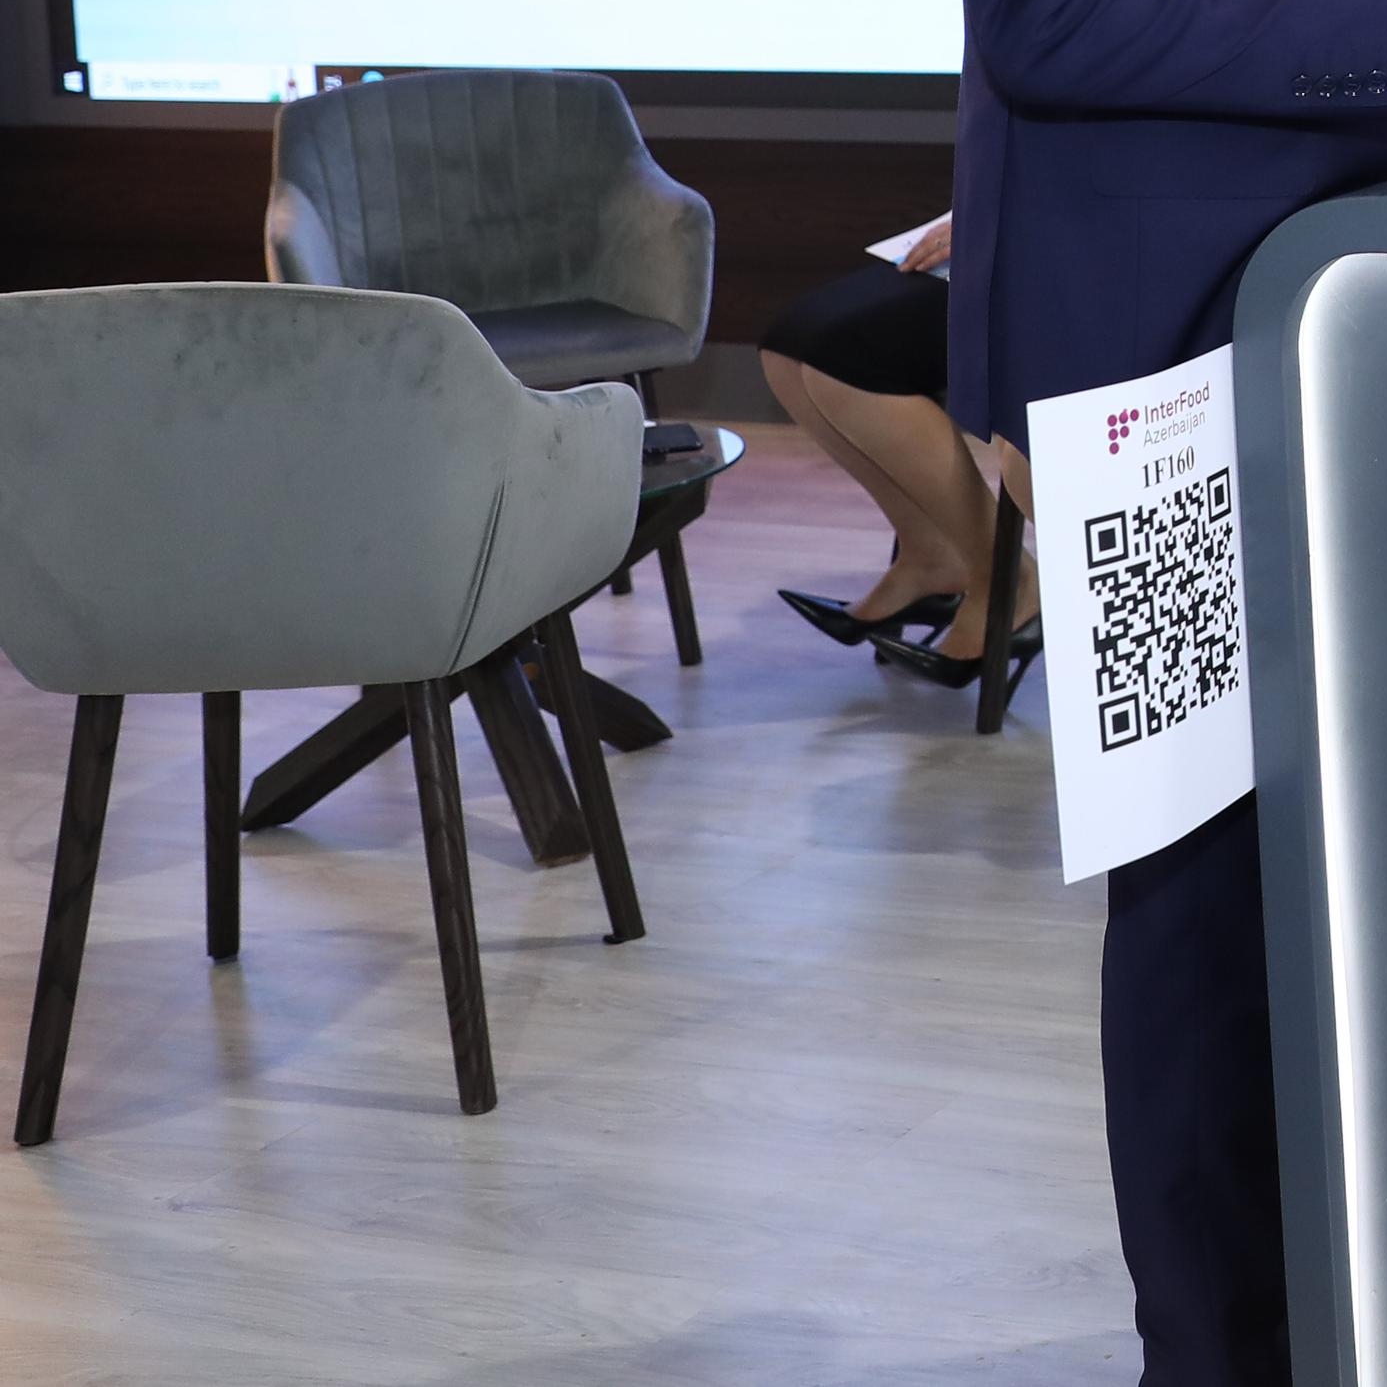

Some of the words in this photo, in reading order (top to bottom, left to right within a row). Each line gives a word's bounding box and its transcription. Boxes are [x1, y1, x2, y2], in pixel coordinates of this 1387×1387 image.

[1144, 381, 1210, 425] InterFood
[1143, 411, 1206, 447] Azerbaijan
[1141, 445, 1195, 489] 1F160
